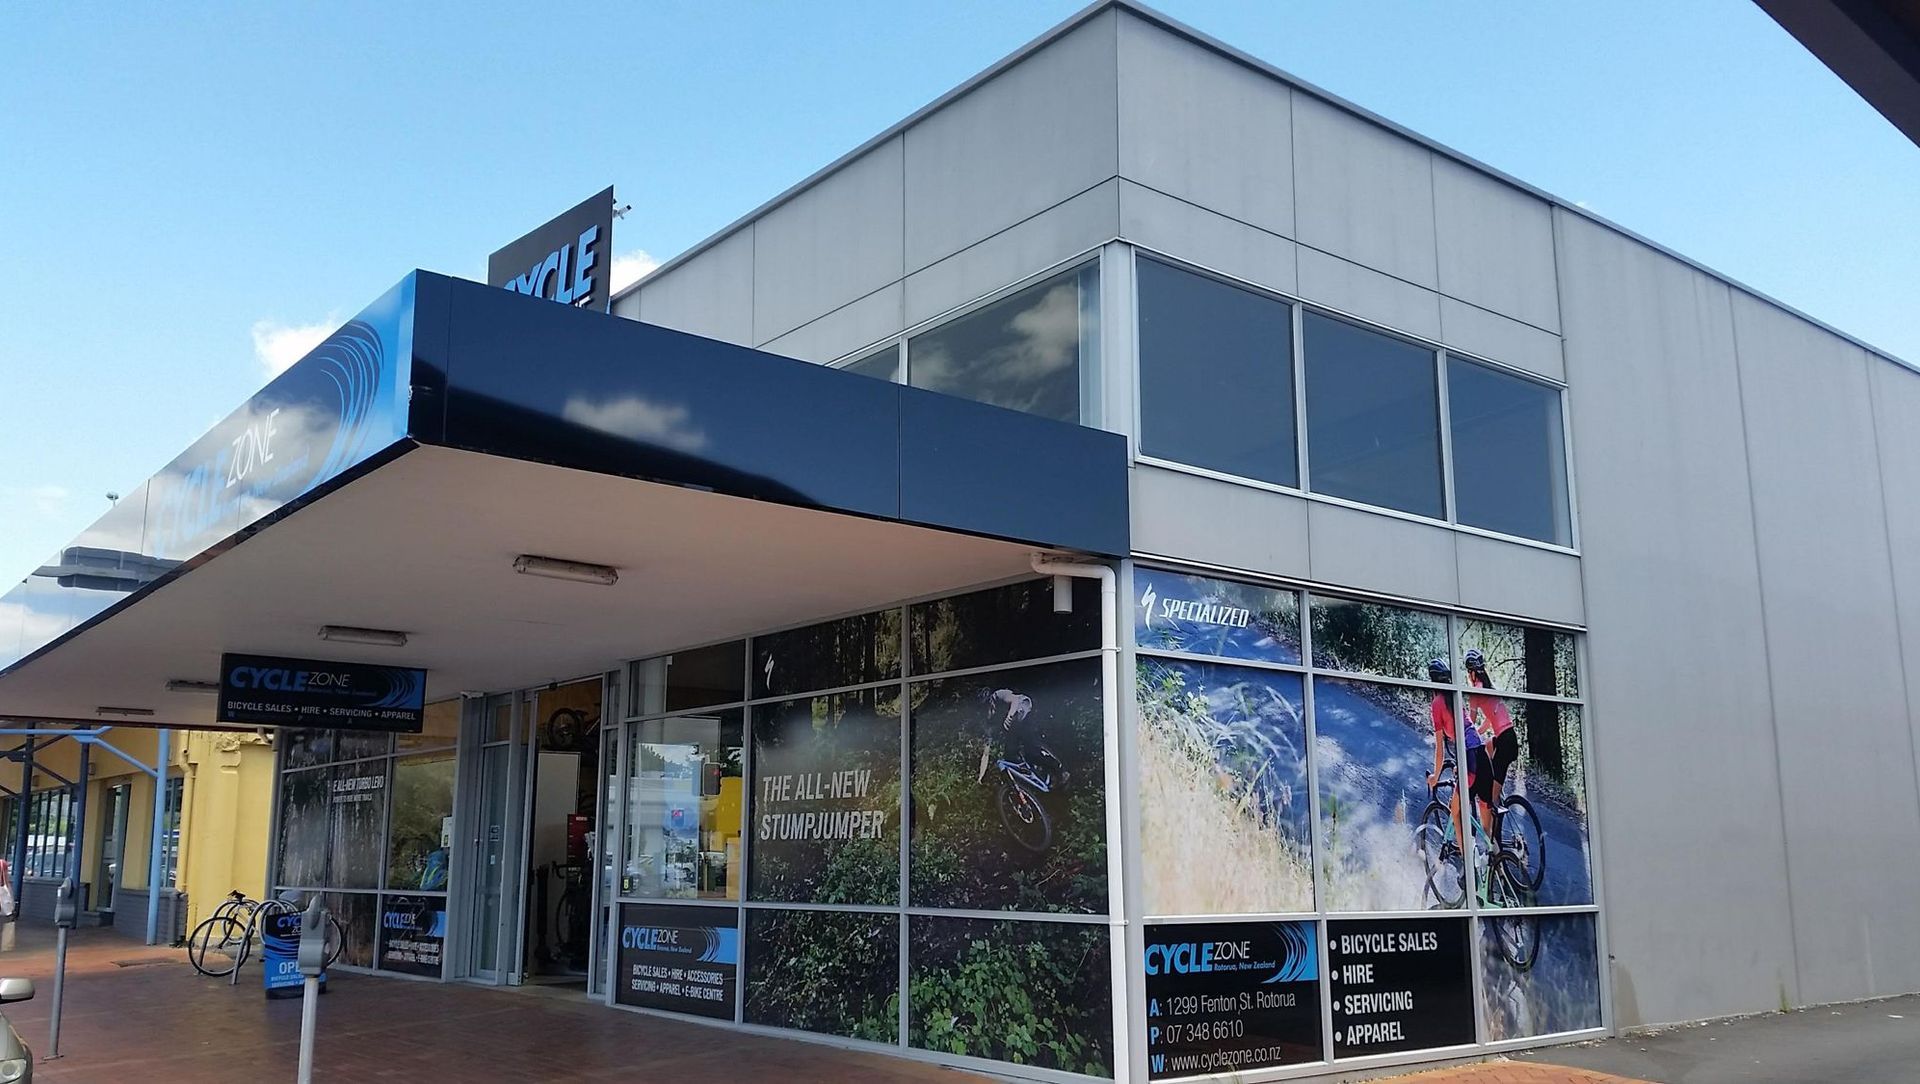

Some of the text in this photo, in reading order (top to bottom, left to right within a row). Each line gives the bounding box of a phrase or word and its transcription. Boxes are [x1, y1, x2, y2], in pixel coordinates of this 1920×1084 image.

[225, 408, 280, 488] ZONE
[1159, 598, 1249, 628] SPECIALIZED
[230, 666, 309, 692] CYCLE
[308, 671, 351, 687] ZONE
[227, 701, 416, 720] BICYCLE SALES HIRE SERVICING APPAREL
[763, 769, 871, 801] THE ALL-NEW
[760, 810, 884, 840] STUMPJUMPER
[622, 926, 679, 951] CYCLE ZONE
[1341, 931, 1438, 955] BICYCLE SALES
[1145, 941, 1251, 975] CYCLE ZONE
[1214, 960, 1275, 972] Rotorua, New Zealand
[632, 964, 652, 977] BICYCLE
[652, 966, 668, 979] SALES
[686, 970, 723, 985] ACCESSORIES
[1343, 964, 1374, 985] HIRE
[631, 979, 724, 1001] SERVICING APPAREL E-BIKE CENTRE
[1345, 990, 1413, 1015] SERVICING
[1149, 991, 1296, 1017] A: 1299 Fenton St. Rotorua
[1151, 1019, 1244, 1045] P: 07 348 6610
[1347, 1021, 1405, 1046] APPAREL
[1151, 1046, 1281, 1073] W: www.cyclezone.co.nz
